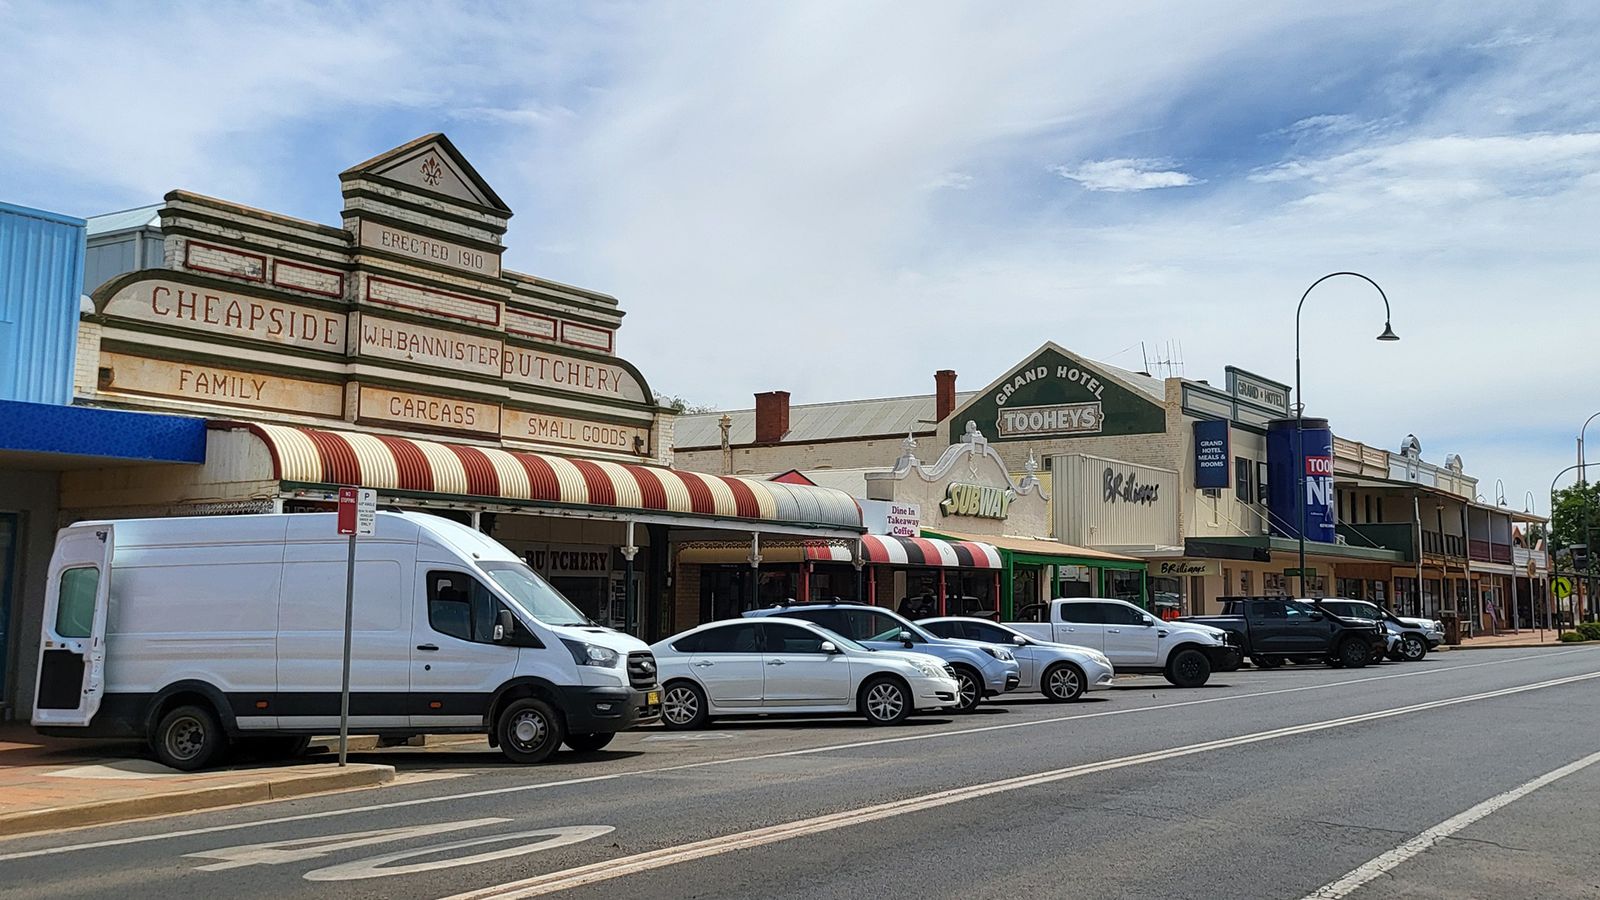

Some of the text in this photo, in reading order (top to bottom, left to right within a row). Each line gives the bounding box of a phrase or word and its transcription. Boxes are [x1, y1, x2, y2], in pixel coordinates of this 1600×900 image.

[382, 231, 483, 269] ERECTED 1910
[152, 286, 339, 345] CHEAPSIDE
[179, 369, 266, 401] FAMILY
[503, 351, 623, 393] BUTCHERY
[995, 366, 1105, 406] GRAND HOTEL
[1238, 381, 1285, 407] GRAND HOTEL
[390, 397, 475, 425] CARCASS
[1003, 406, 1096, 432] TOOHEYS
[528, 418, 627, 446] SMALL GOODS
[364, 492, 370, 500] P
[891, 505, 907, 515] Dine
[946, 482, 1013, 518] SUBWAY
[887, 516, 919, 527] Takeaway
[893, 526, 913, 535] Coffee
[525, 550, 608, 571] BUTCHERY
